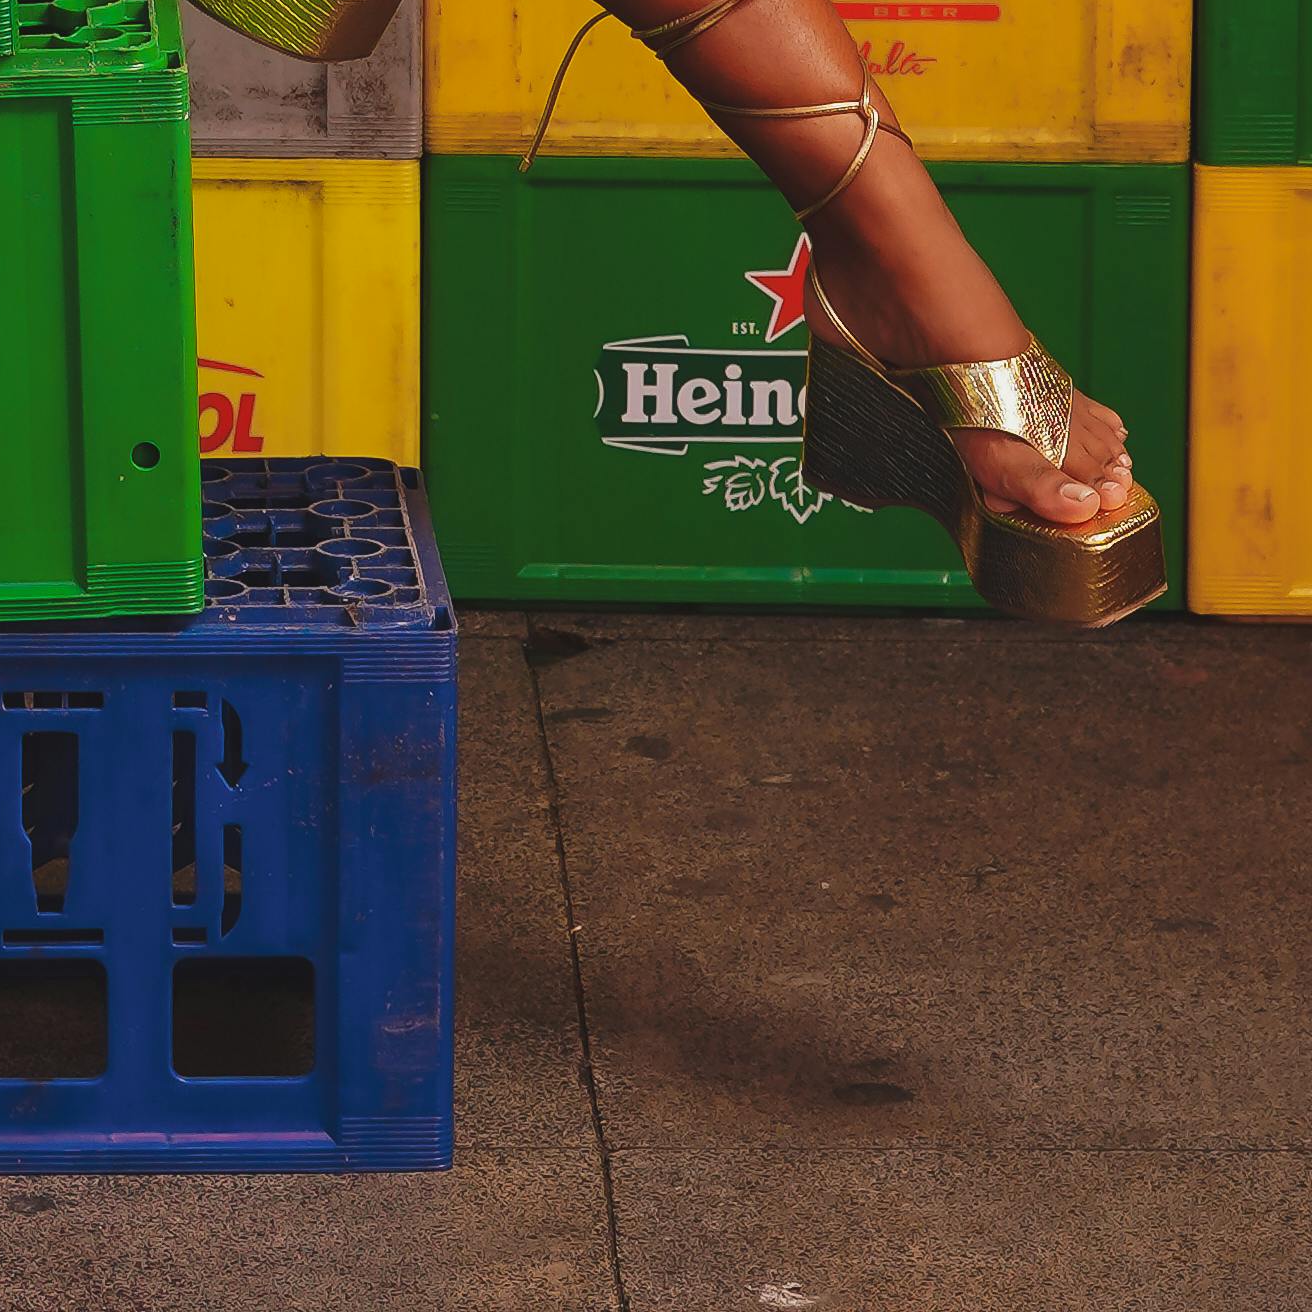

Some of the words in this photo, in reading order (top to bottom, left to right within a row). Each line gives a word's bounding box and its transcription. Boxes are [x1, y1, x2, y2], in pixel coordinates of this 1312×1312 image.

[874, 7, 958, 17] BEER
[732, 322, 759, 335] EST.
[621, 362, 806, 426] Hein
